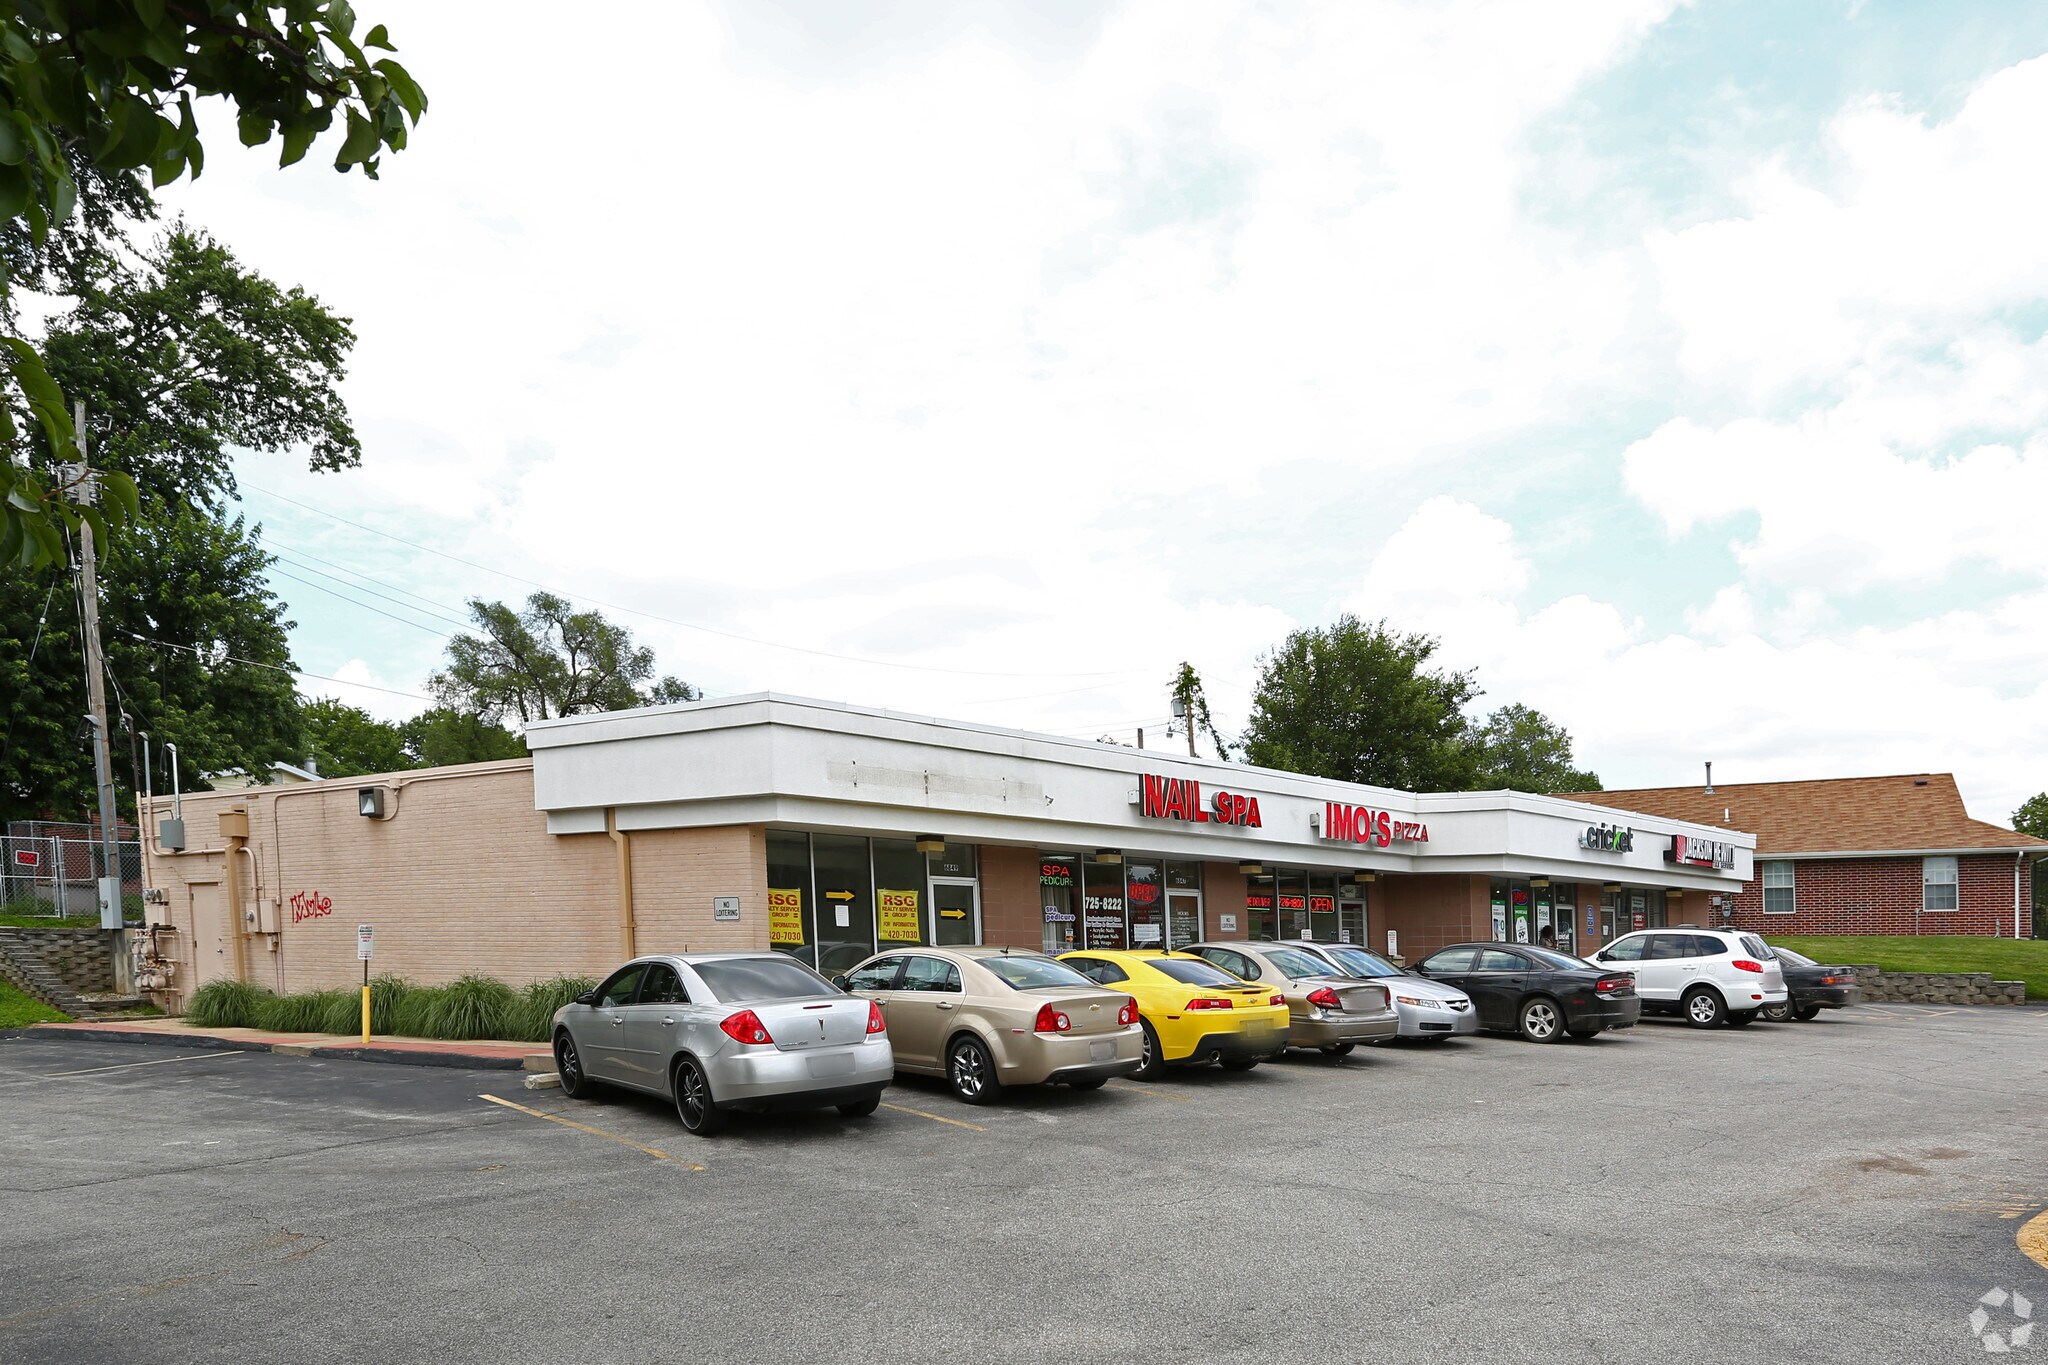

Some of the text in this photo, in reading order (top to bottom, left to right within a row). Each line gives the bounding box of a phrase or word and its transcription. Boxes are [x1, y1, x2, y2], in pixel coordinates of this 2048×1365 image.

[1141, 773, 1262, 828] NAIL SPA
[1326, 801, 1429, 848] IMO'S PIZZA
[1586, 822, 1634, 853] cricket
[1685, 837, 1713, 861] JACKSON
[1042, 865, 1070, 876] SPA
[1040, 876, 1074, 886] PEDICURE
[1128, 882, 1158, 902] OPEN
[883, 895, 915, 907] RSG
[1085, 896, 1122, 910] 725-8222
[1310, 897, 1333, 911] OPEN
[716, 909, 738, 917] LOITERING
[1046, 913, 1076, 921] pedicure
[888, 930, 918, 939] 420-7030
